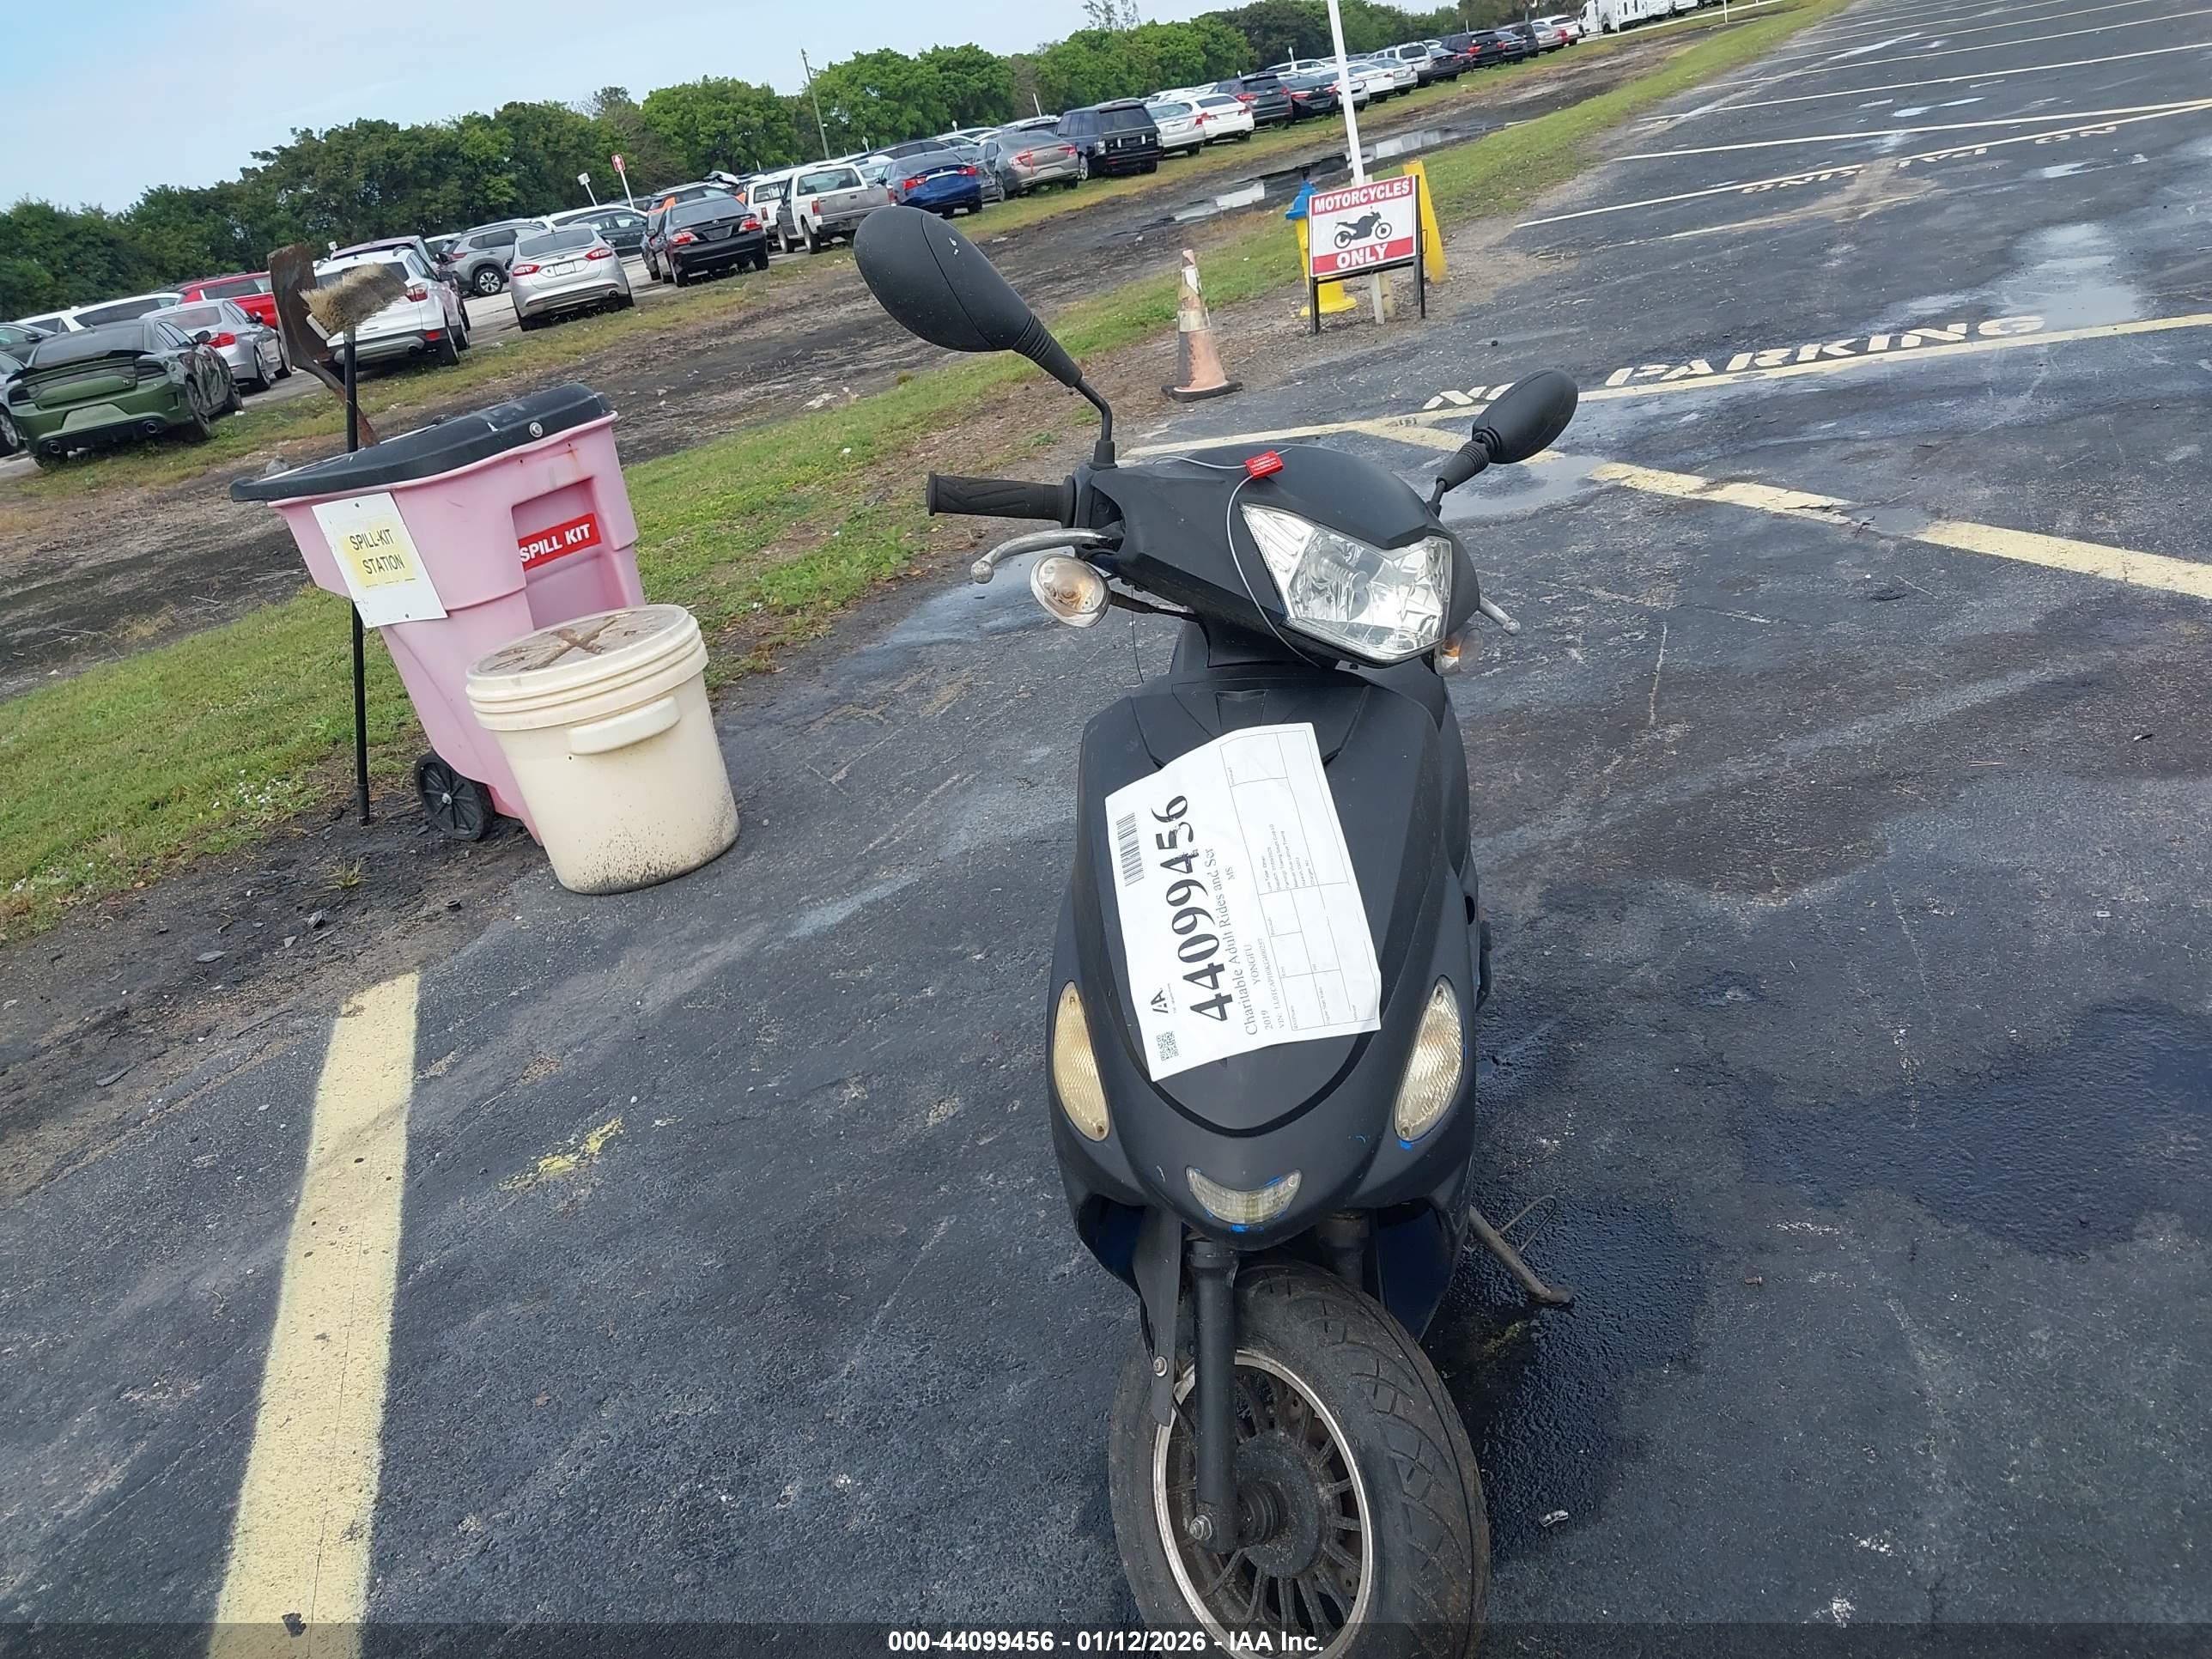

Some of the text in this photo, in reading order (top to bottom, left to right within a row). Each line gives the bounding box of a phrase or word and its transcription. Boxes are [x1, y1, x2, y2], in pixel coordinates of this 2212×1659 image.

[1314, 179, 1410, 214] MOTORCYCLES
[1335, 243, 1389, 269] ONLY
[1605, 315, 2046, 387] PARKING
[349, 529, 395, 550] SPILL-KIT
[520, 523, 591, 562] SPILL KIT
[362, 554, 405, 574] STATION
[1206, 869, 1223, 891] and
[1224, 866, 1236, 880] MS
[1151, 795, 1233, 1022] 44099456
[1215, 893, 1231, 928] Rides
[1222, 931, 1241, 964] Adult
[1231, 968, 1258, 1036] Charitable
[1243, 944, 1273, 1030] 2019 YONGFU
